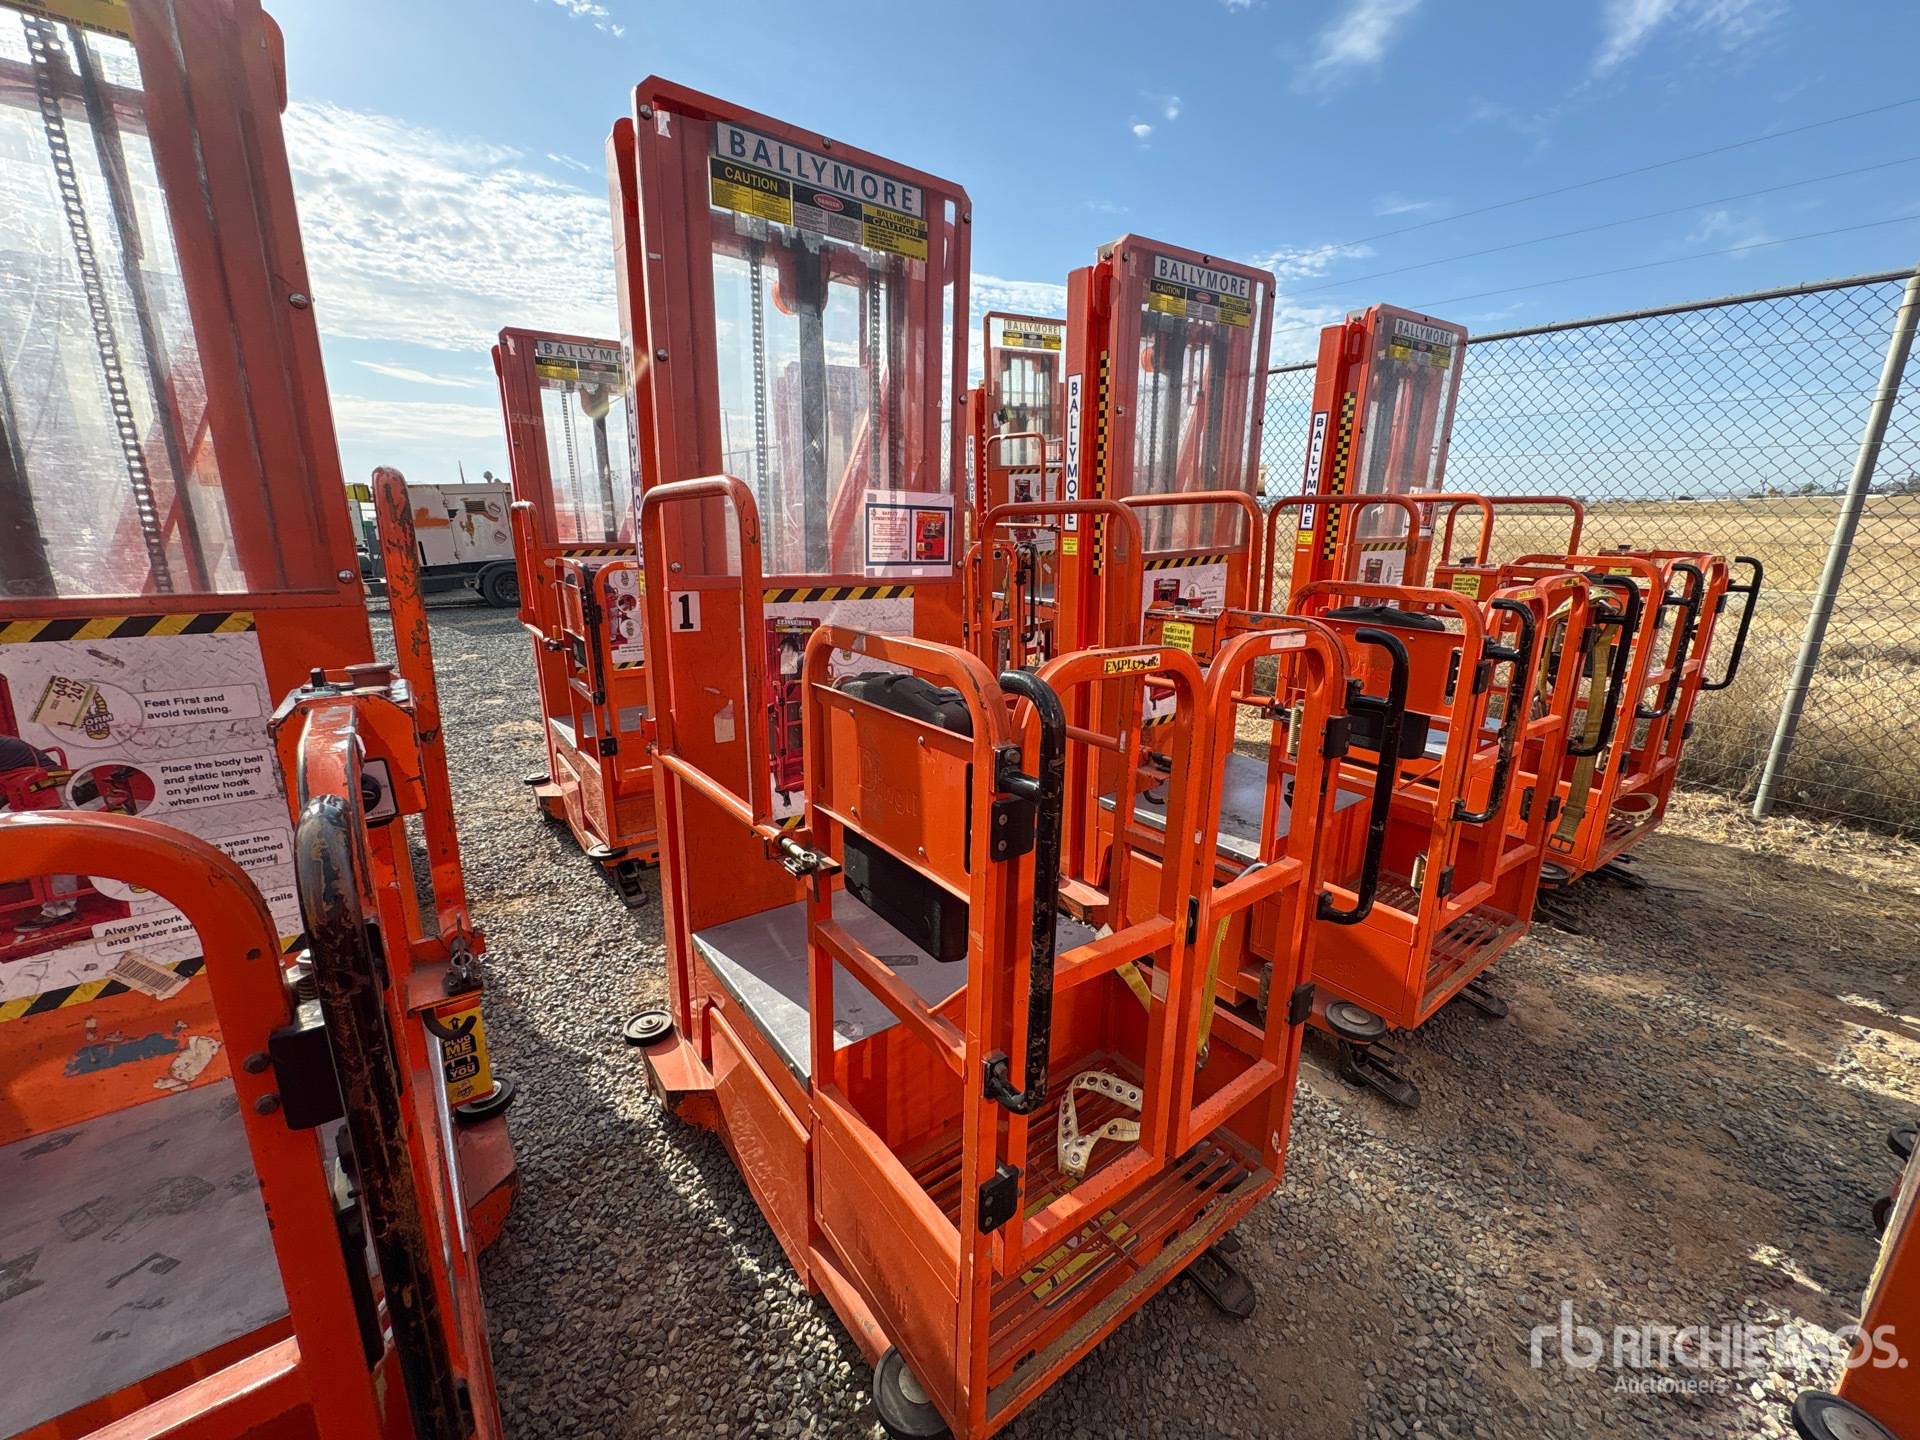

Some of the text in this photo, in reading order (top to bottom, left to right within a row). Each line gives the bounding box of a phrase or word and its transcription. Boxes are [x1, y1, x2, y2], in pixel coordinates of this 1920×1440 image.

[724, 166, 778, 193] CAUTION
[729, 129, 913, 212] BALLYMORE
[817, 197, 840, 210] DANGER
[872, 217, 919, 237] CAUTION
[876, 209, 915, 227] BALLYMORE
[1160, 259, 1245, 296] BALLYMORE
[1155, 284, 1181, 296] CAUTION
[1223, 302, 1247, 313] CAUTION
[1007, 320, 1058, 335] BALLYMORE
[1398, 320, 1450, 345] BALLYMORE
[543, 342, 622, 363] BALLYMO
[541, 358, 570, 368] CAUTION
[1067, 381, 1078, 525] BALLYMOE
[678, 594, 694, 629] 1
[144, 693, 225, 708] Feet First and
[147, 705, 232, 720] avoid twisting.
[161, 754, 264, 774] Place the body belt
[163, 766, 262, 785] and static lanyard
[166, 778, 250, 797] on yellow hook
[169, 789, 259, 808] when not in use.
[224, 838, 250, 848] wear
[252, 835, 270, 843] the
[238, 842, 284, 857] attached
[237, 854, 273, 867] anyard
[104, 914, 183, 937] Always work
[106, 936, 131, 948] and
[134, 928, 169, 942] never
[270, 893, 294, 903] rails
[444, 1034, 471, 1047] PLUG
[445, 1041, 472, 1056] ME
[450, 1064, 476, 1078] YOU
